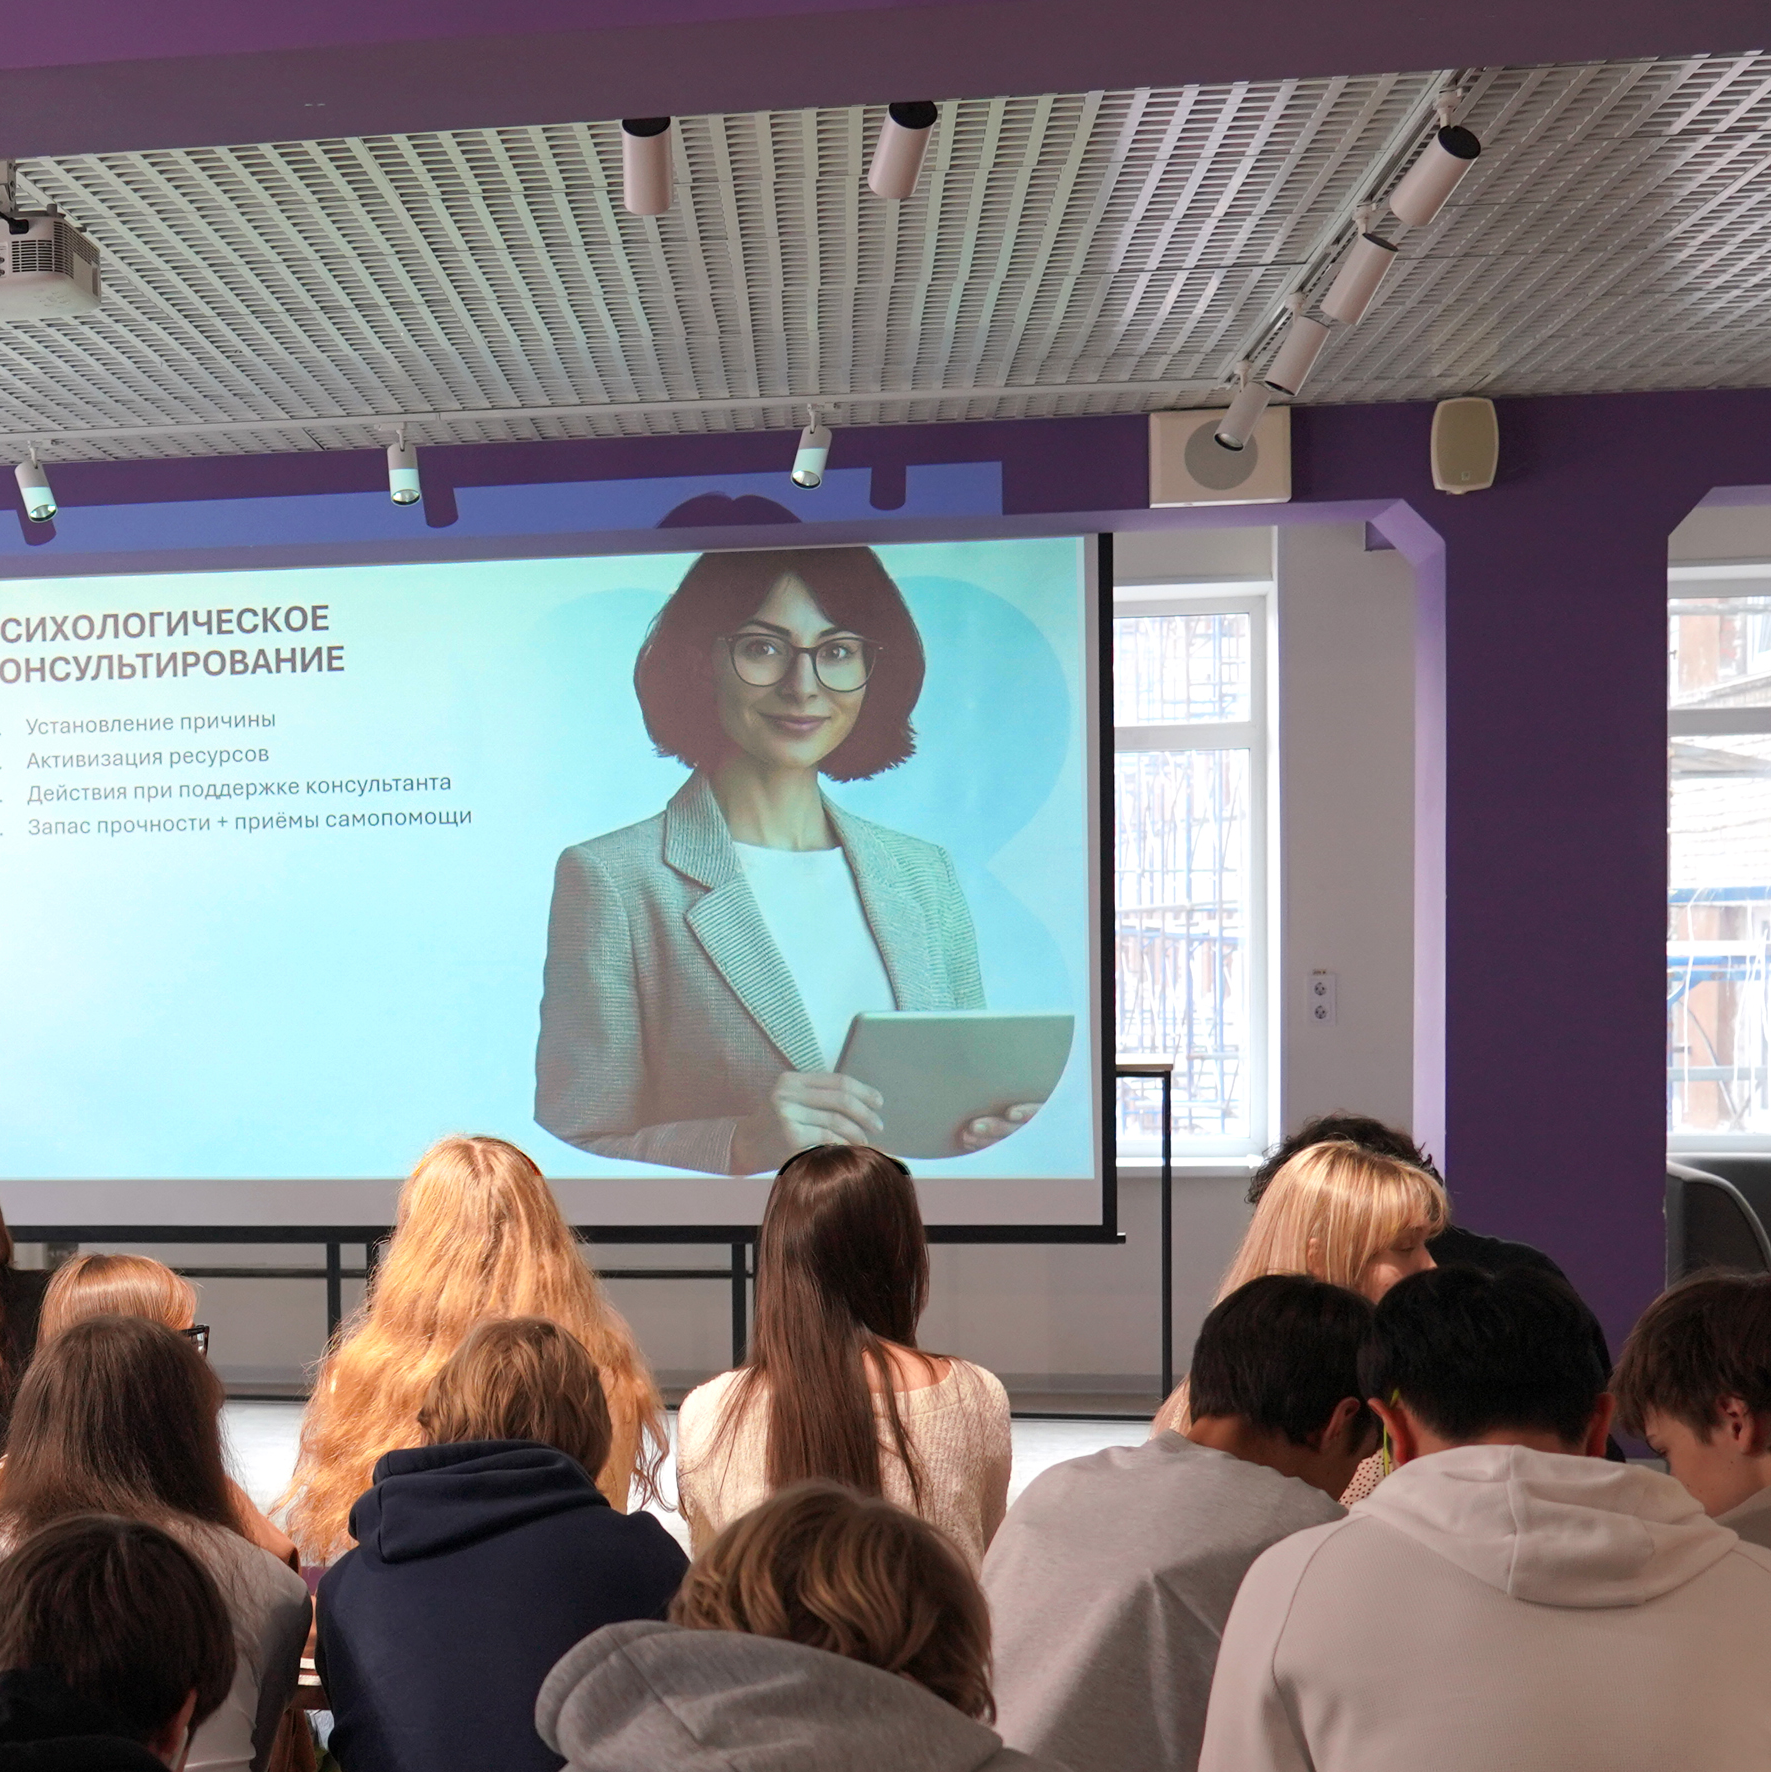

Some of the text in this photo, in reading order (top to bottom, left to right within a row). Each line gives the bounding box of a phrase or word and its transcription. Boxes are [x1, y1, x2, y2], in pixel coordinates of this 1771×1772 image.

[25, 715, 175, 736] Установление
[179, 713, 277, 734] причины
[26, 751, 164, 769] Активизация
[169, 747, 270, 769] ресурсов
[27, 784, 127, 806] Действия
[133, 784, 173, 803] при
[179, 780, 300, 800] поддержке
[305, 776, 452, 797] консультанта
[28, 818, 91, 836] Запас
[97, 816, 211, 838] прочности
[234, 811, 319, 834] приёмы
[325, 809, 473, 828] самопомощи
